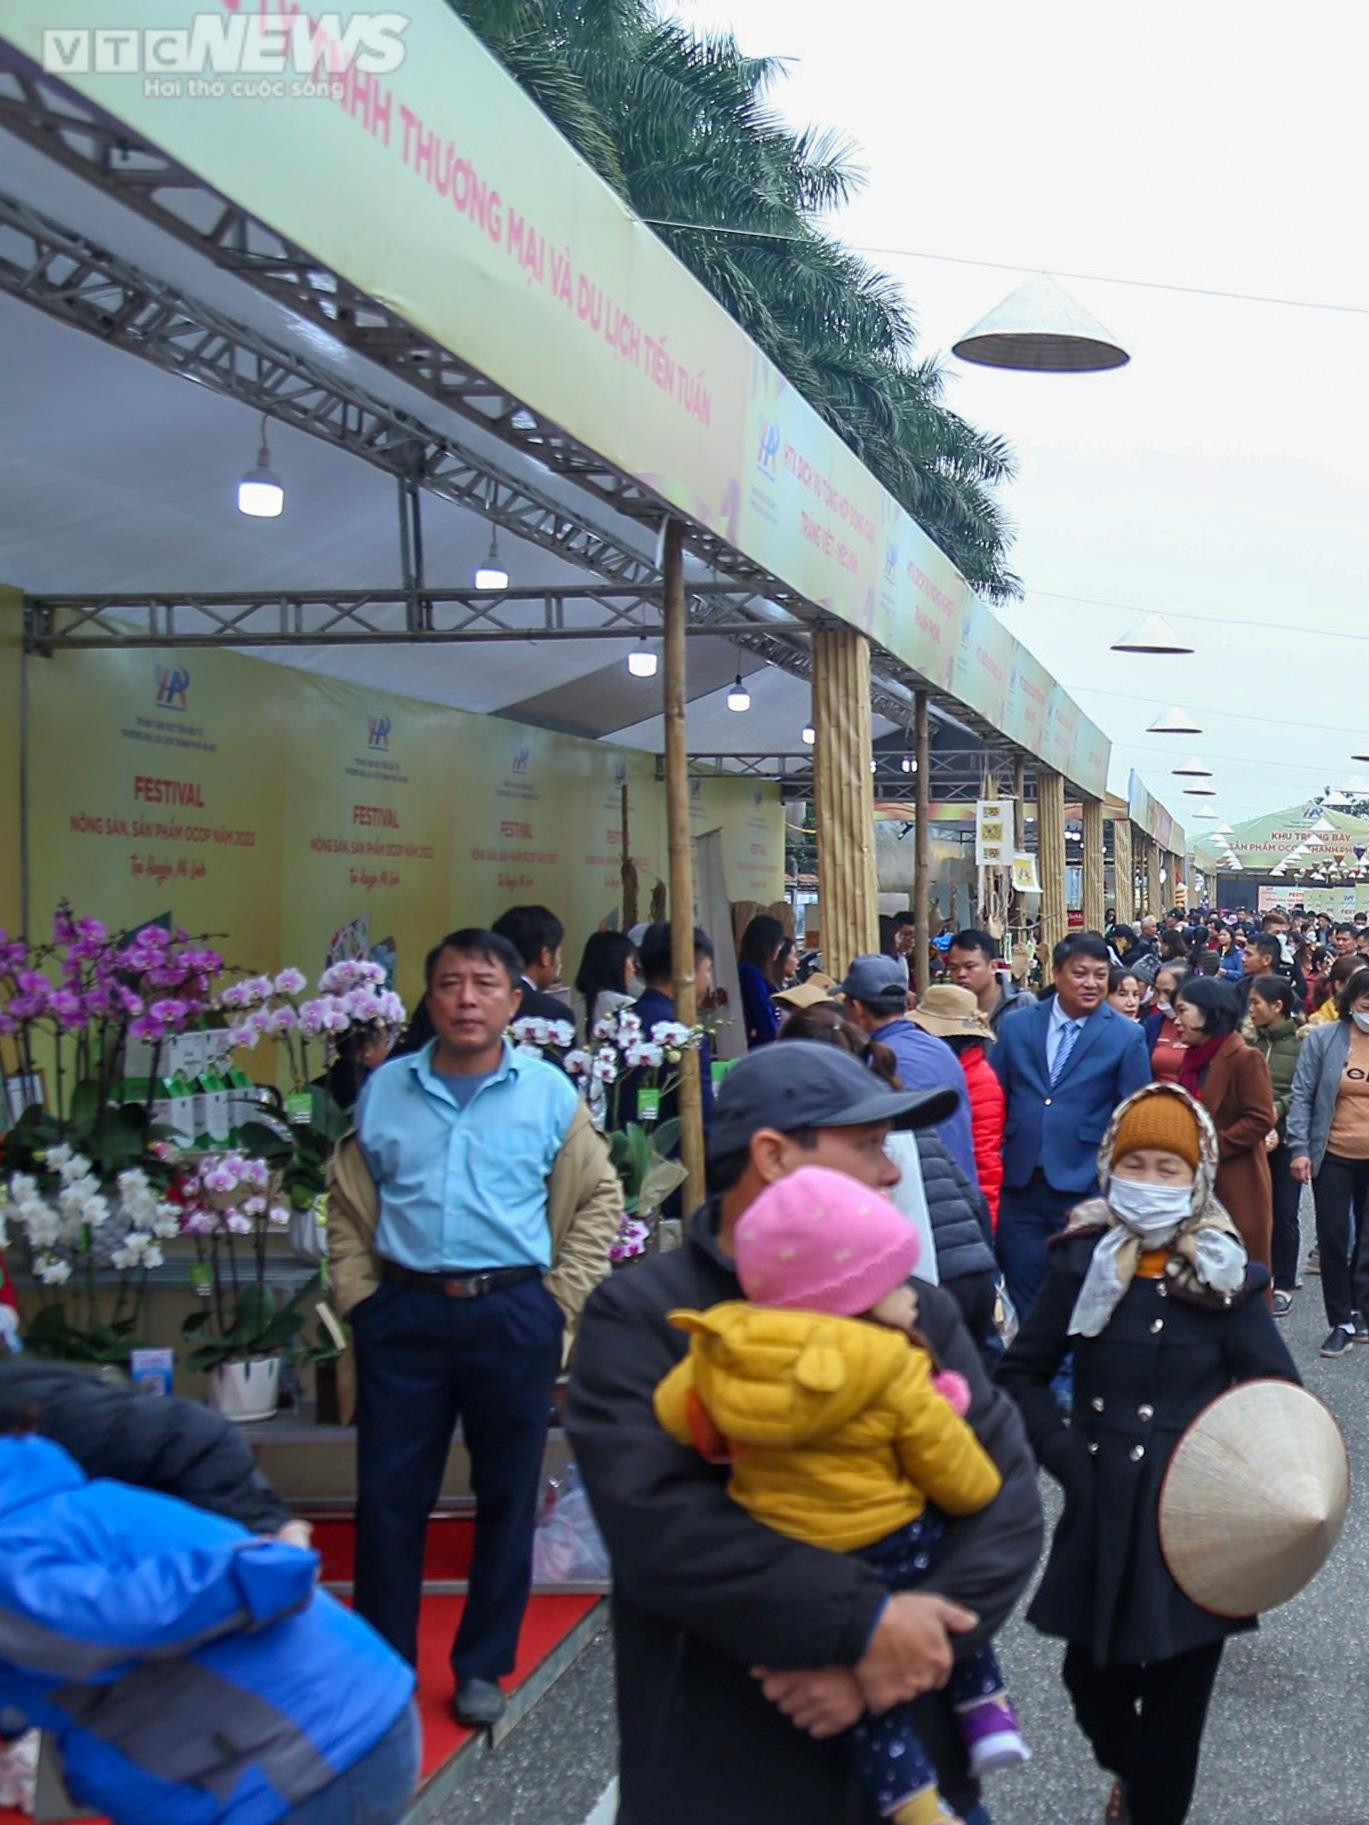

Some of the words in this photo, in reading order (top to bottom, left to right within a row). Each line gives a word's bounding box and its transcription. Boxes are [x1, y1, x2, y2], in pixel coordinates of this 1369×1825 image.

[400, 104, 502, 244] THƯƠNG
[507, 207, 545, 288] MẠI
[551, 246, 572, 310] VÀ
[577, 272, 602, 332] DU
[605, 300, 640, 367] LỊCH
[134, 776, 205, 808] FESTIVAL
[353, 805, 400, 829] FESTIVAL
[1271, 831, 1292, 840] KHU
